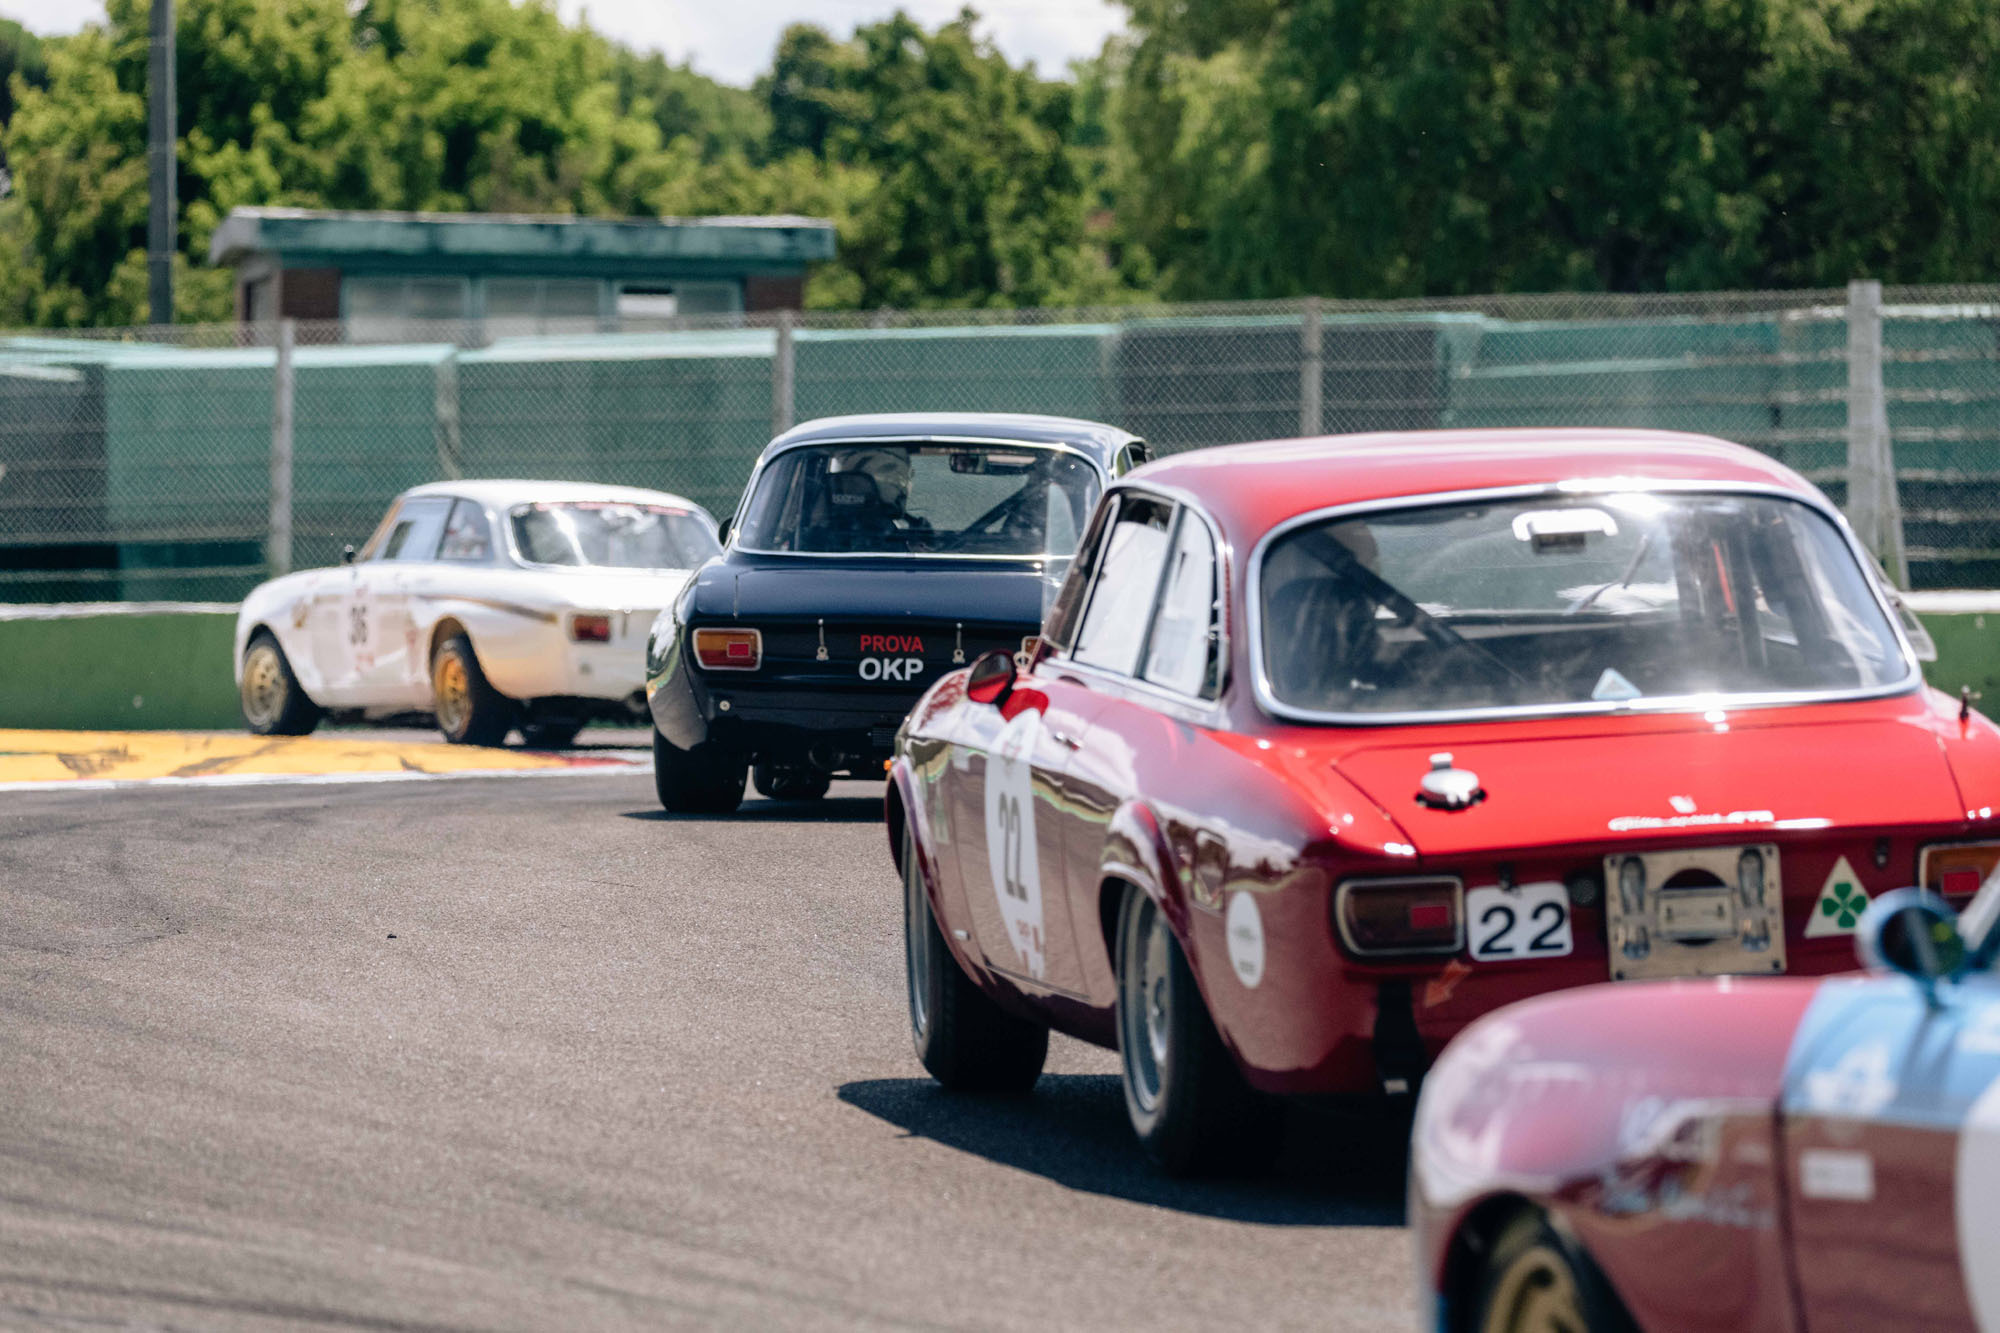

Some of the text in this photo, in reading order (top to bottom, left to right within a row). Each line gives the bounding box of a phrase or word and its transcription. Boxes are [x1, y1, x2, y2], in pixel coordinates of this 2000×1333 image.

[860, 634, 924, 653] PROVA
[858, 657, 924, 681] OKP
[999, 791, 1028, 901] 22
[1479, 902, 1565, 954] 22
